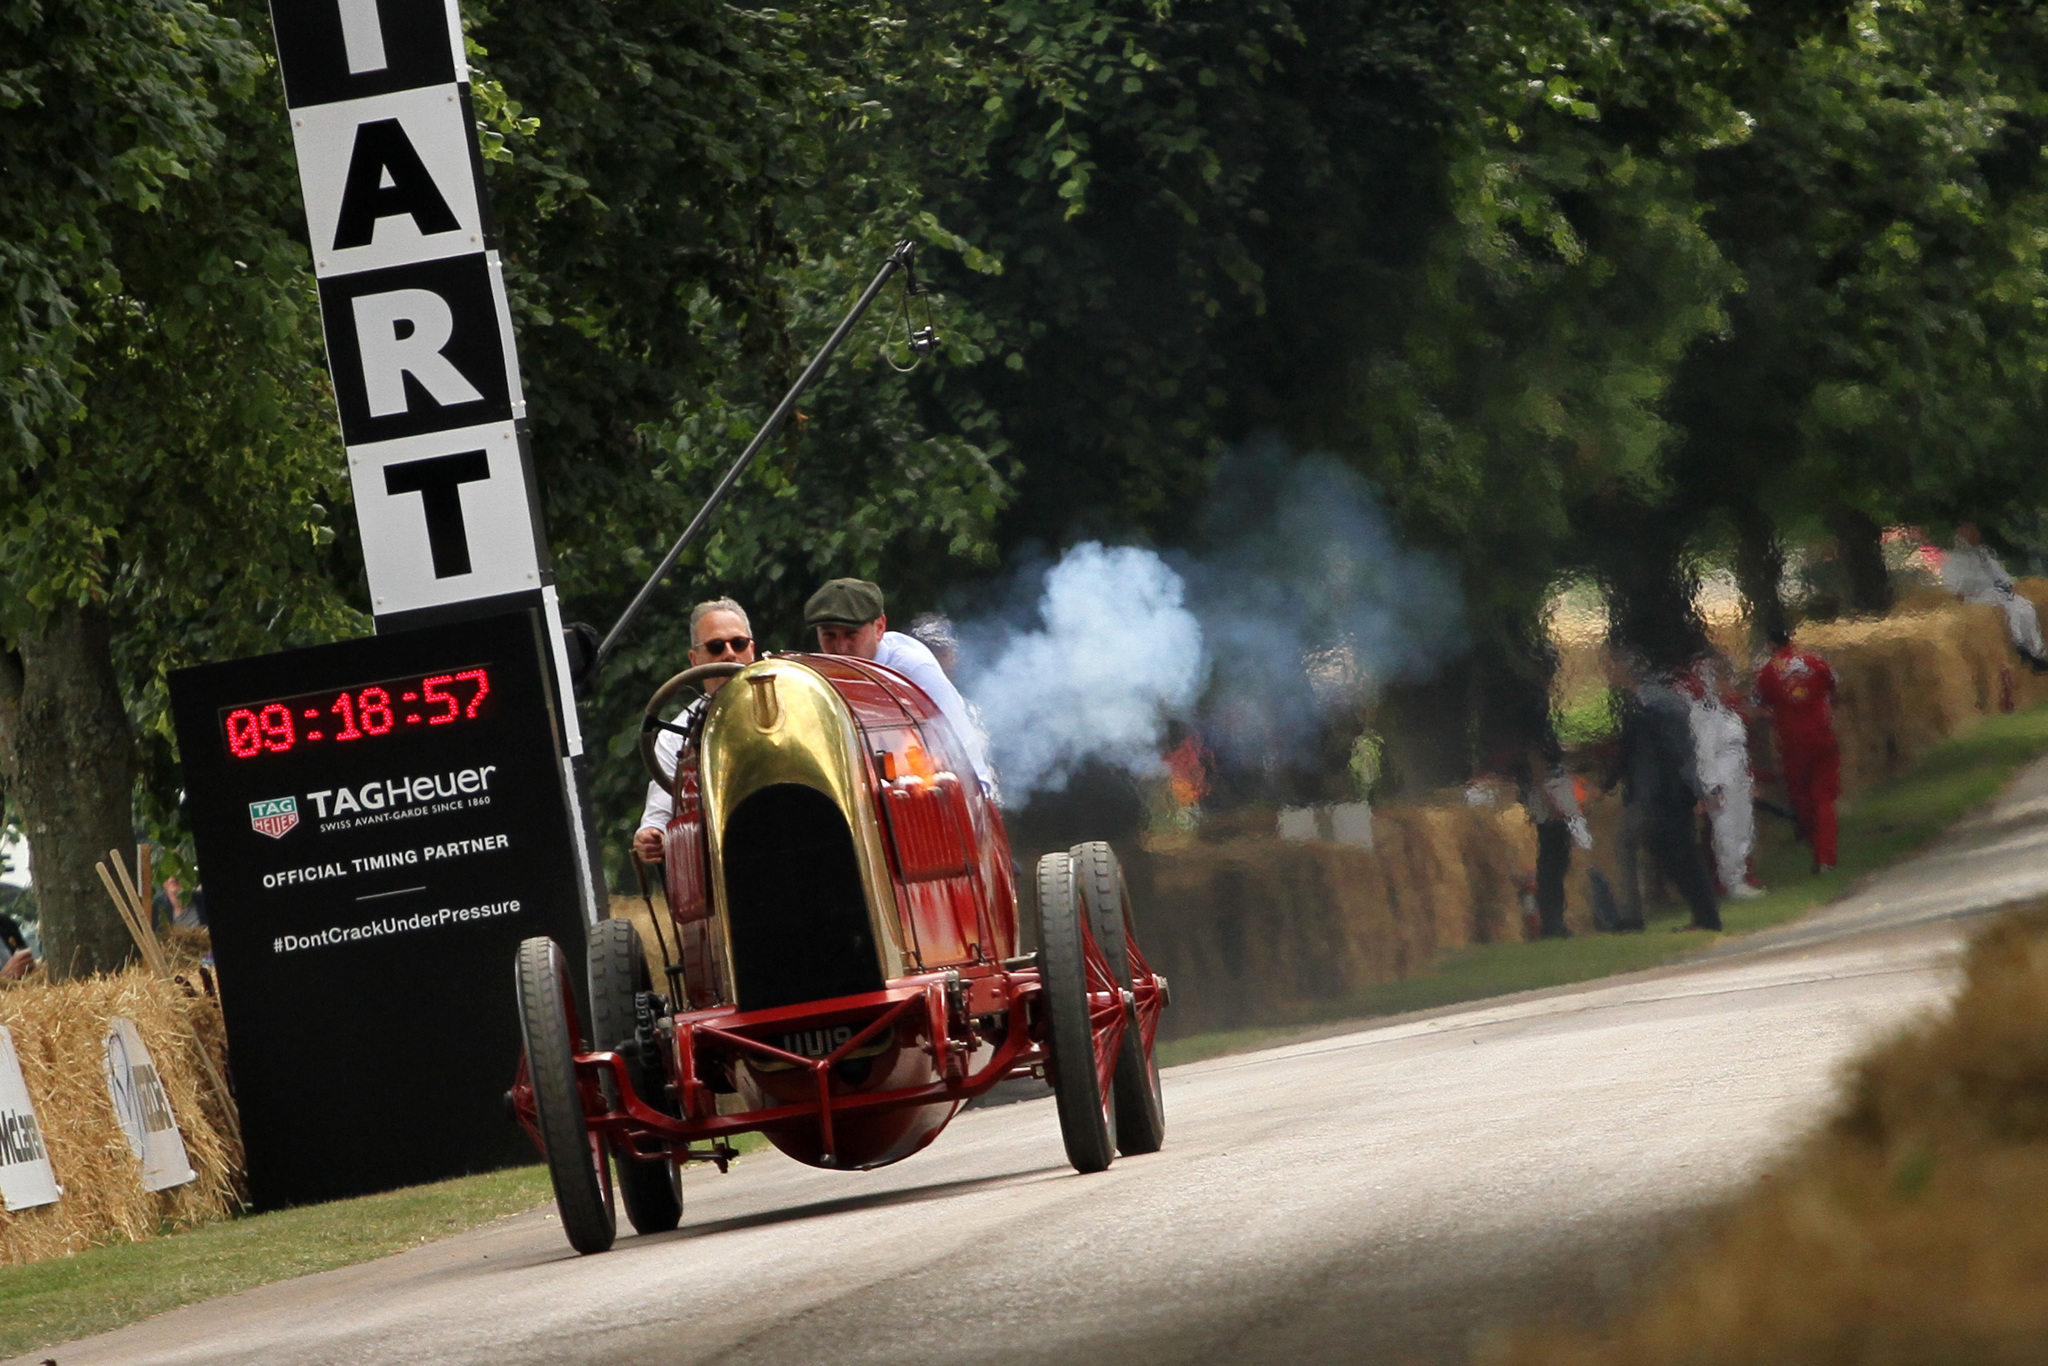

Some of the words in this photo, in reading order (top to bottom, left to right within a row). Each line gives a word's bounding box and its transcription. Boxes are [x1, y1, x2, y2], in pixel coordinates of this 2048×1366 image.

[226, 669, 489, 757] 09:18:57
[253, 799, 293, 816] TAG
[254, 814, 296, 836] HEUER
[320, 819, 351, 833] SWISS
[355, 805, 429, 827] AVANT-GARDE
[431, 800, 463, 814] SINCE
[467, 795, 491, 807] 1860
[263, 862, 347, 888] OFFICIAL
[351, 850, 418, 873] TIMING
[424, 834, 509, 861] PARTNER
[273, 899, 521, 953] #DontCrackUnderPressure
